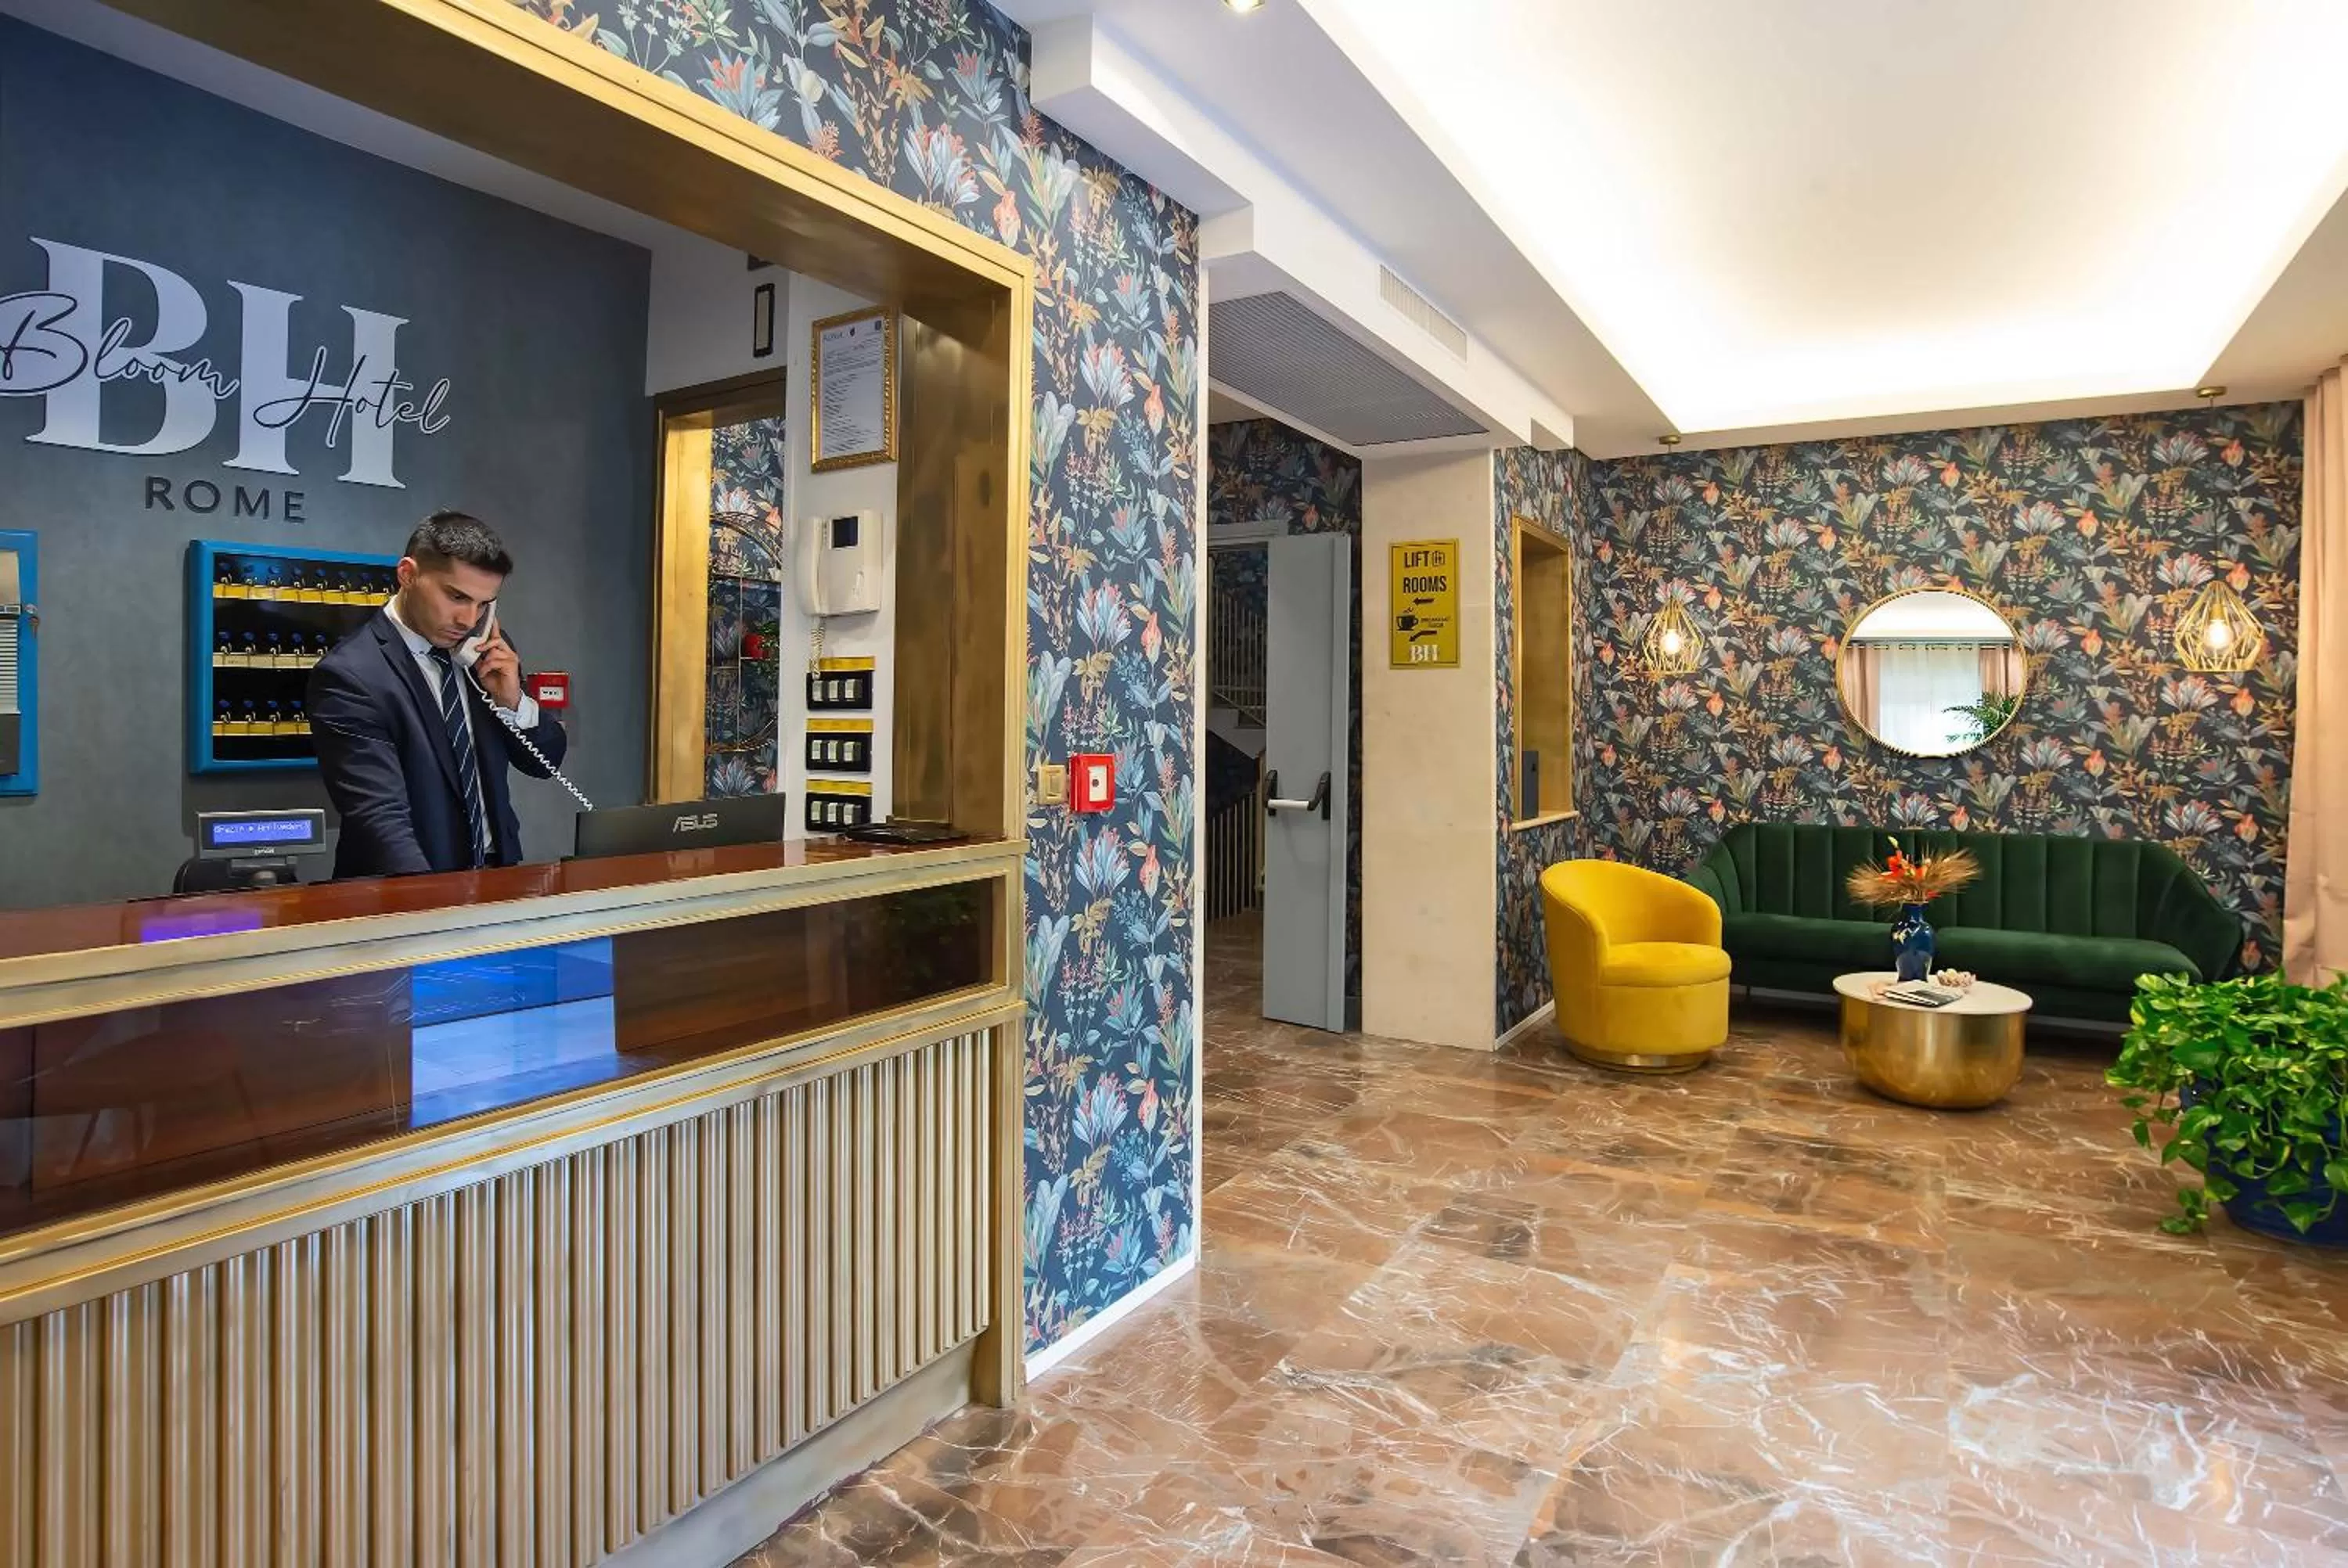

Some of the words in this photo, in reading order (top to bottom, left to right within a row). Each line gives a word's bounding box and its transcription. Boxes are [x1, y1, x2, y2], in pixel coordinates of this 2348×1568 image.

[0, 291, 239, 398] Bloom
[253, 346, 451, 448] Hotel
[27, 236, 409, 489] BH
[145, 476, 306, 523] ROME
[1404, 550, 1430, 568] LIFT
[1403, 575, 1447, 594] ROOMS
[1410, 644, 1439, 662] BH
[672, 813, 718, 833] ASUS
